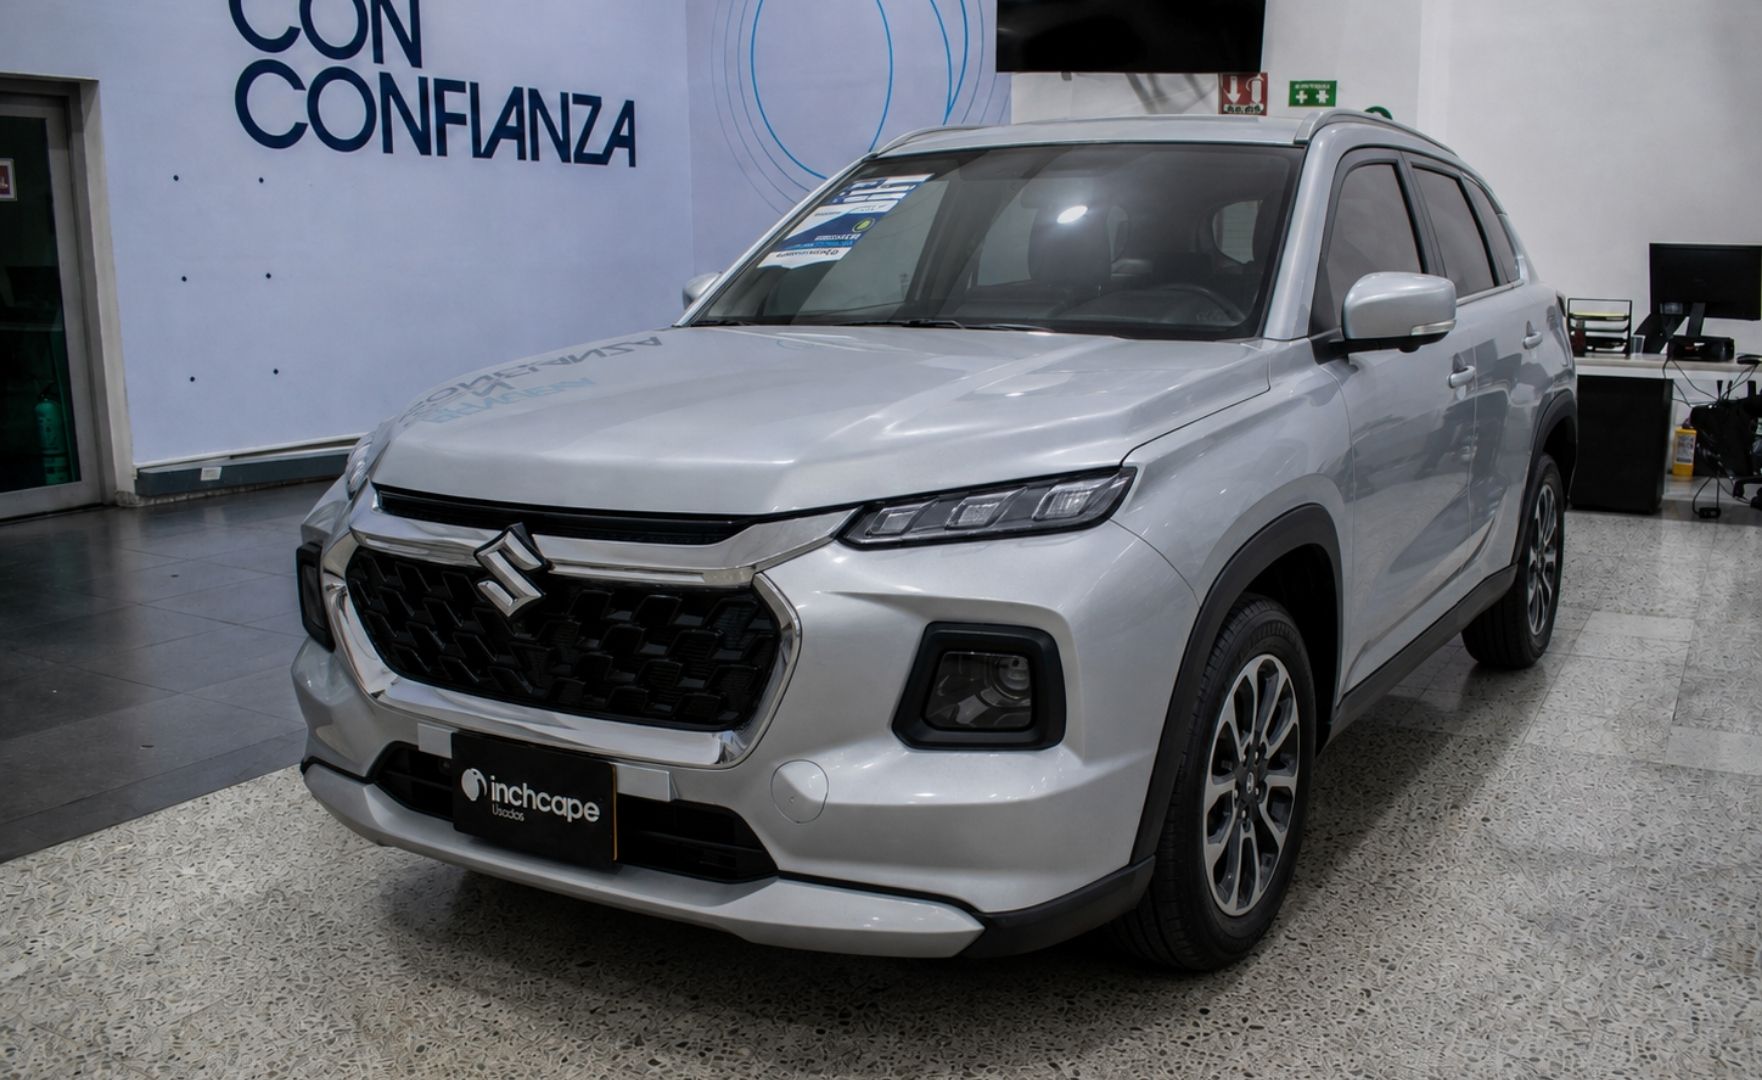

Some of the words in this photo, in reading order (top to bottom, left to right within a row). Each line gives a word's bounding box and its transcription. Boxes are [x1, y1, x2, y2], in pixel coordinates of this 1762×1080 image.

[228, 0, 422, 68] CON
[234, 59, 636, 168] CONFIANZA
[490, 775, 600, 822] inchcape
[492, 803, 525, 822] Usados
